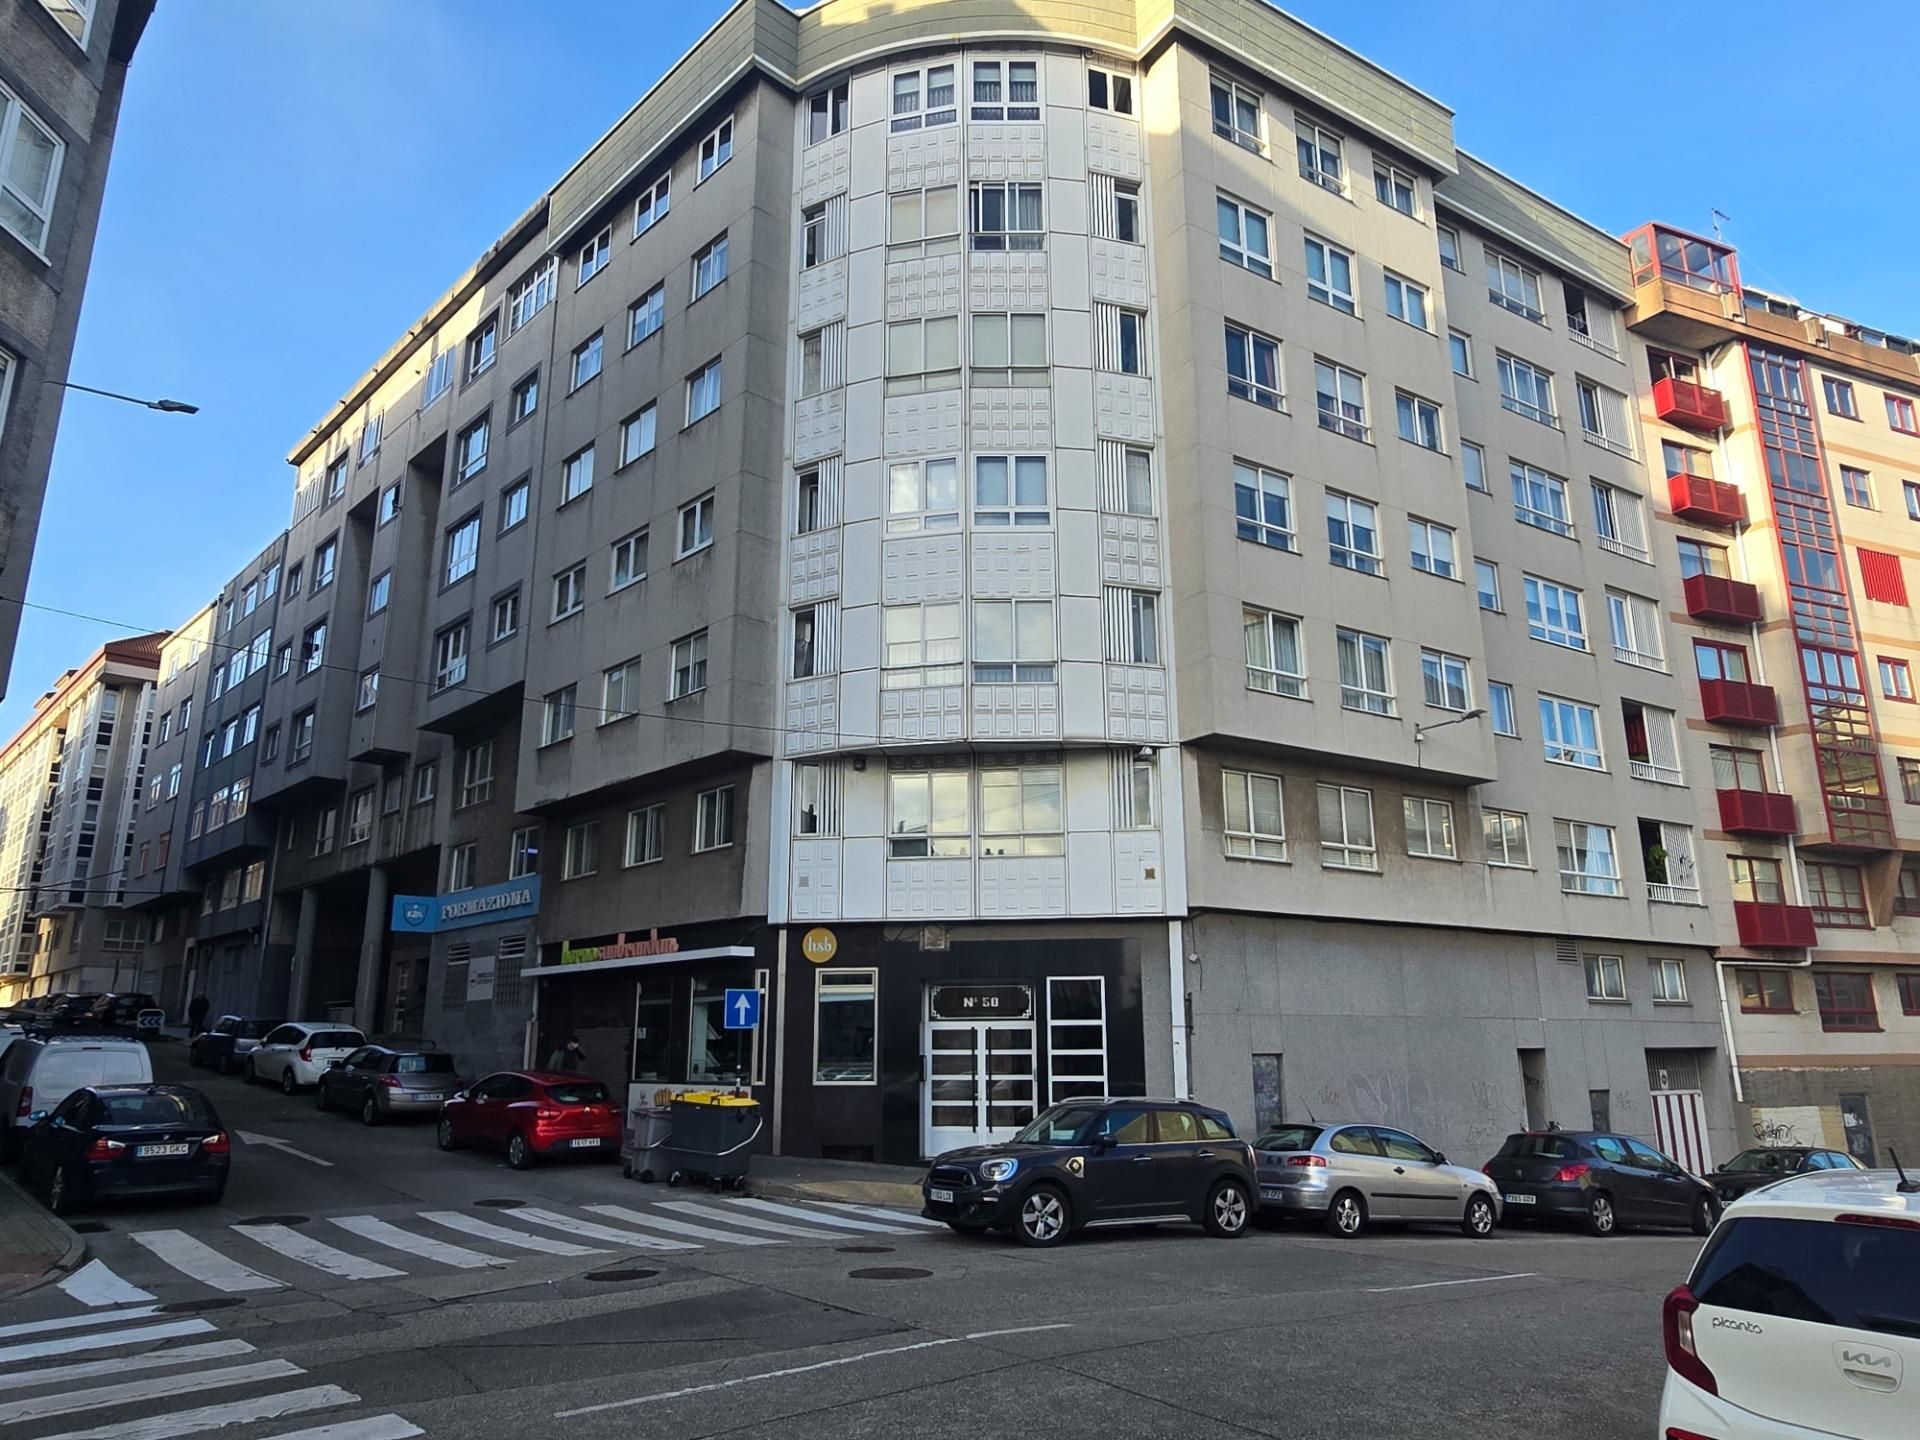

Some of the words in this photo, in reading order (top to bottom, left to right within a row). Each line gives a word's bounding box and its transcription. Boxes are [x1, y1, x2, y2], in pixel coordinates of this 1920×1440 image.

[440, 889, 532, 921] FORMAZIONA
[982, 997, 999, 1007] 50
[144, 1145, 167, 1155] 9523
[169, 1145, 187, 1153] GKC
[1712, 1317, 1763, 1334] picanto
